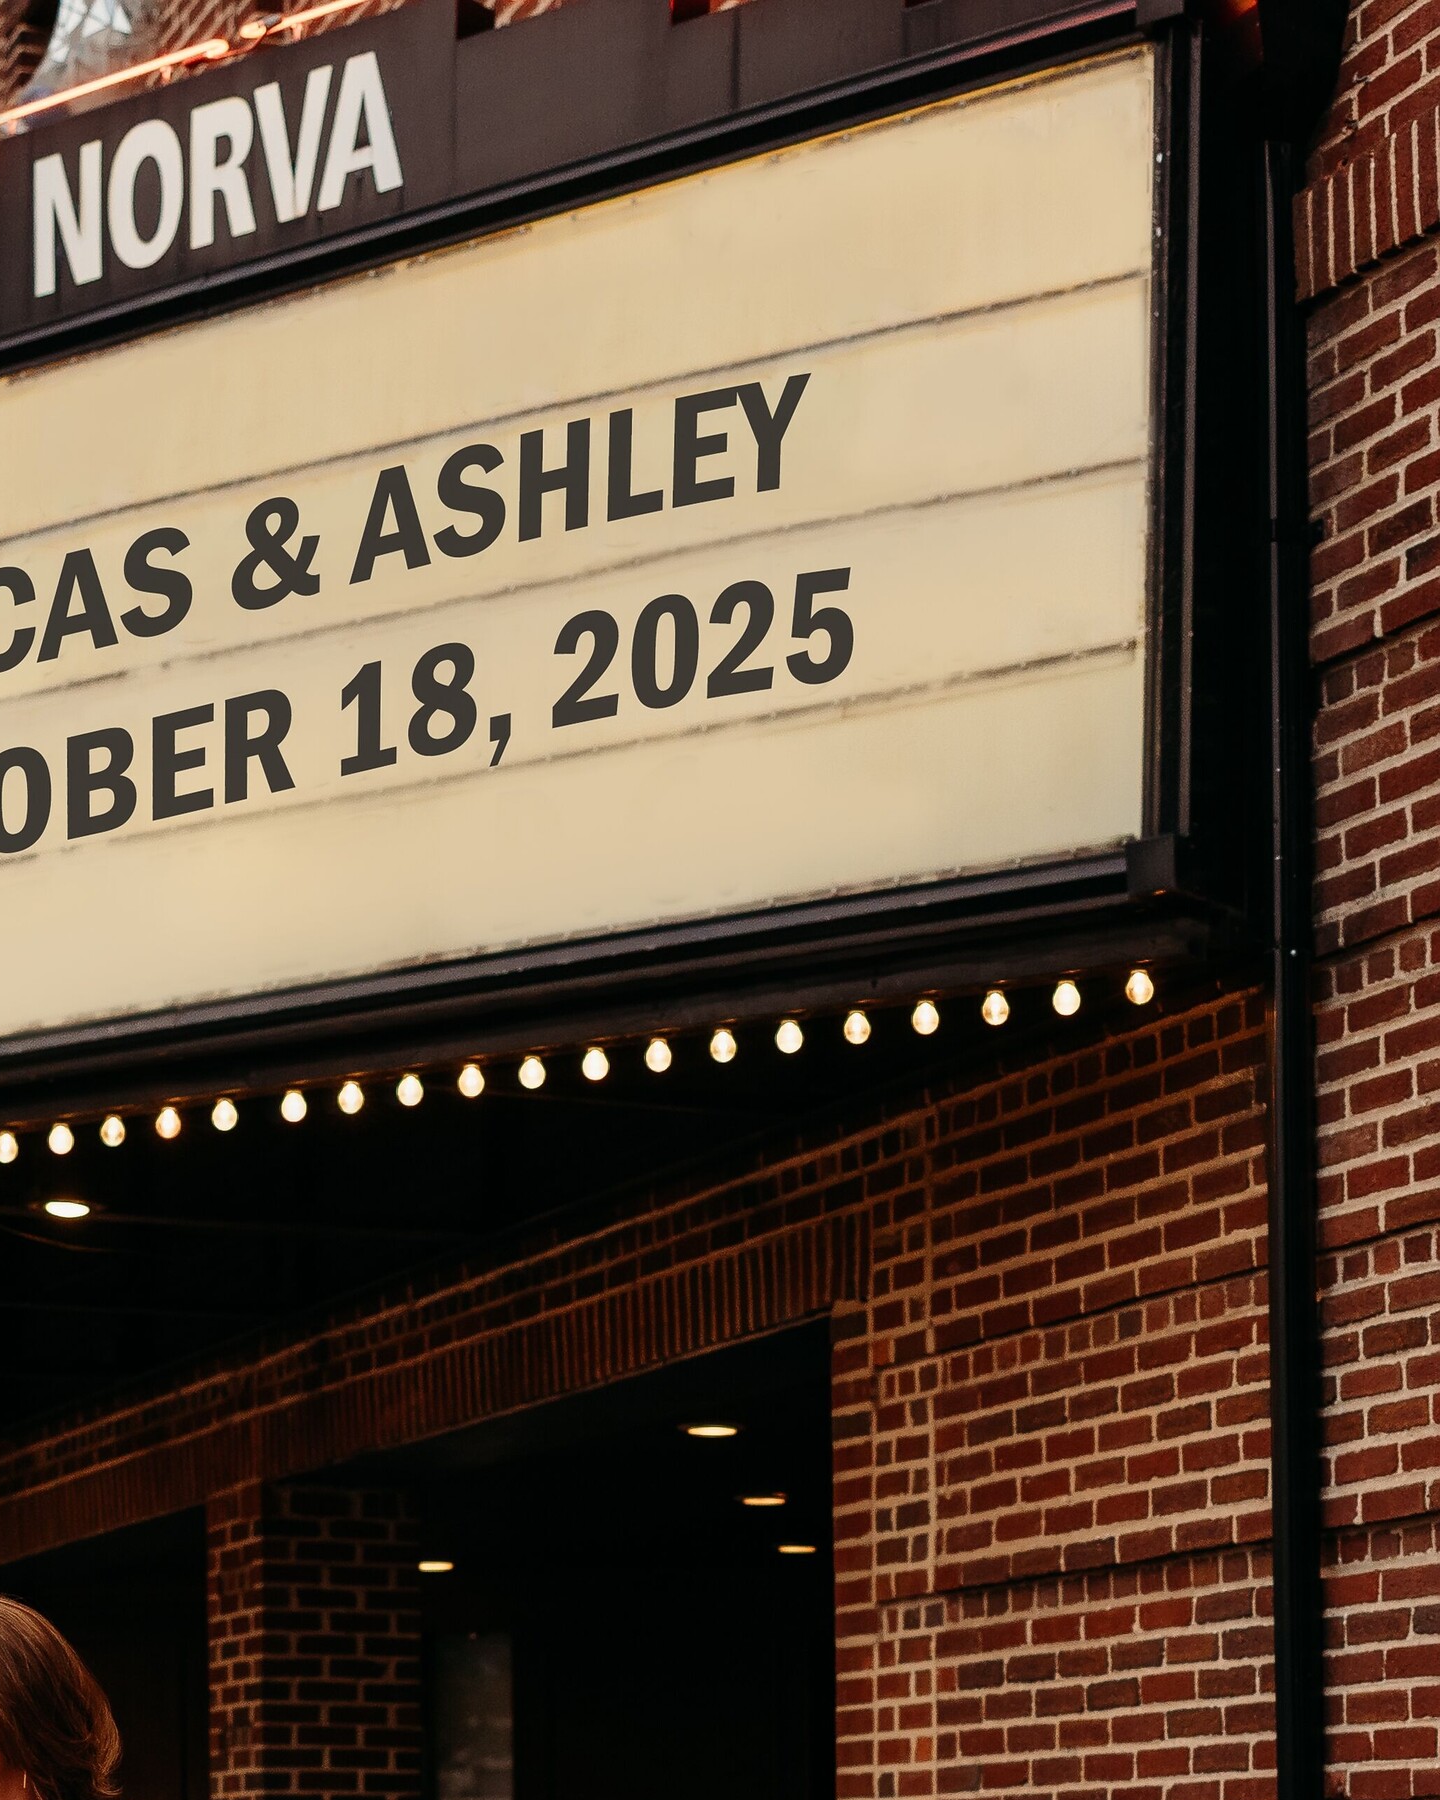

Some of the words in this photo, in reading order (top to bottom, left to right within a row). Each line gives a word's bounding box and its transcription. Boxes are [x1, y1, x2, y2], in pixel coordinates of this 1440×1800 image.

[32, 50, 404, 299] NORVA
[231, 496, 321, 611] &
[349, 372, 812, 585] ASHLEY
[340, 642, 512, 777] 18,
[552, 566, 854, 729] 2025
